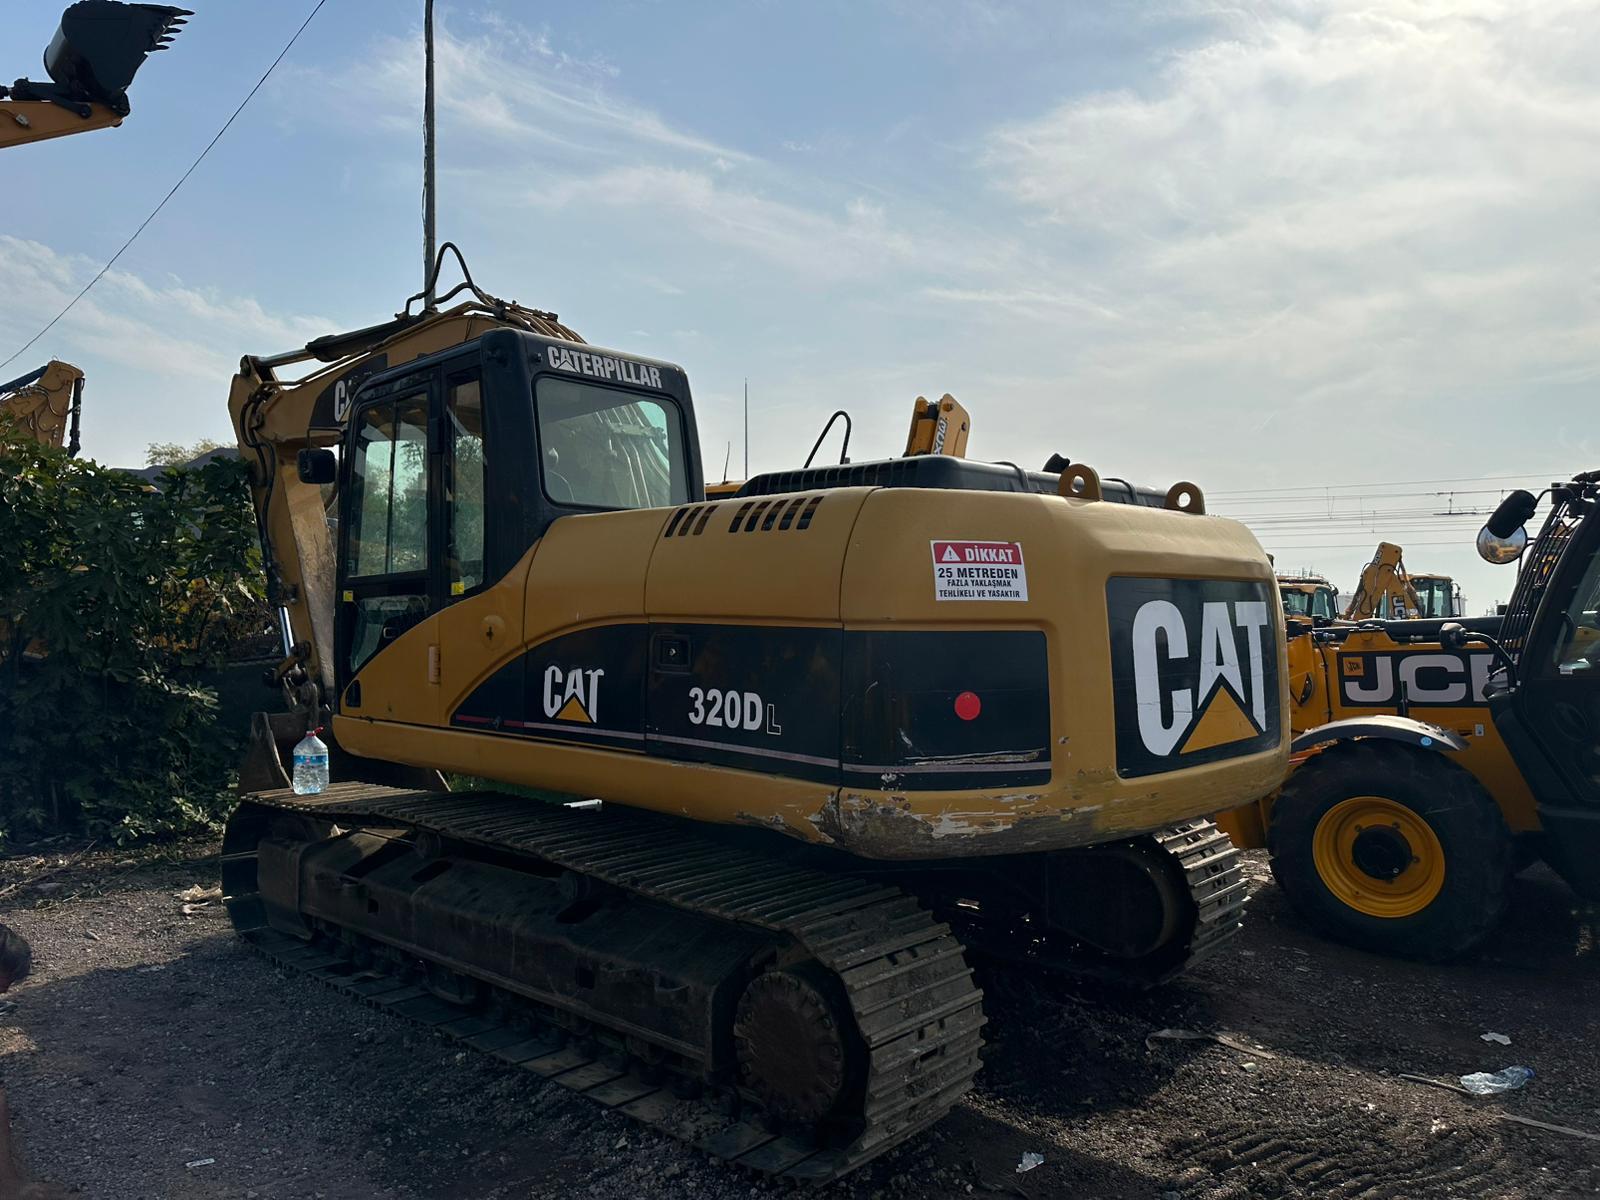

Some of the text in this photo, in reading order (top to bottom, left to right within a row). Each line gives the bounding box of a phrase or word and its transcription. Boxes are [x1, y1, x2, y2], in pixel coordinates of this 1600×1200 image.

[547, 345, 662, 388] CATERPILLAR
[964, 545, 1013, 562] DİKKAT
[938, 567, 1018, 579] 25 METREDEN
[947, 579, 1012, 588] FAZLA YAKLAŞMAK
[987, 590, 1020, 598] YASAKTIR
[1133, 600, 1268, 756] CAT
[543, 665, 605, 723] CAT
